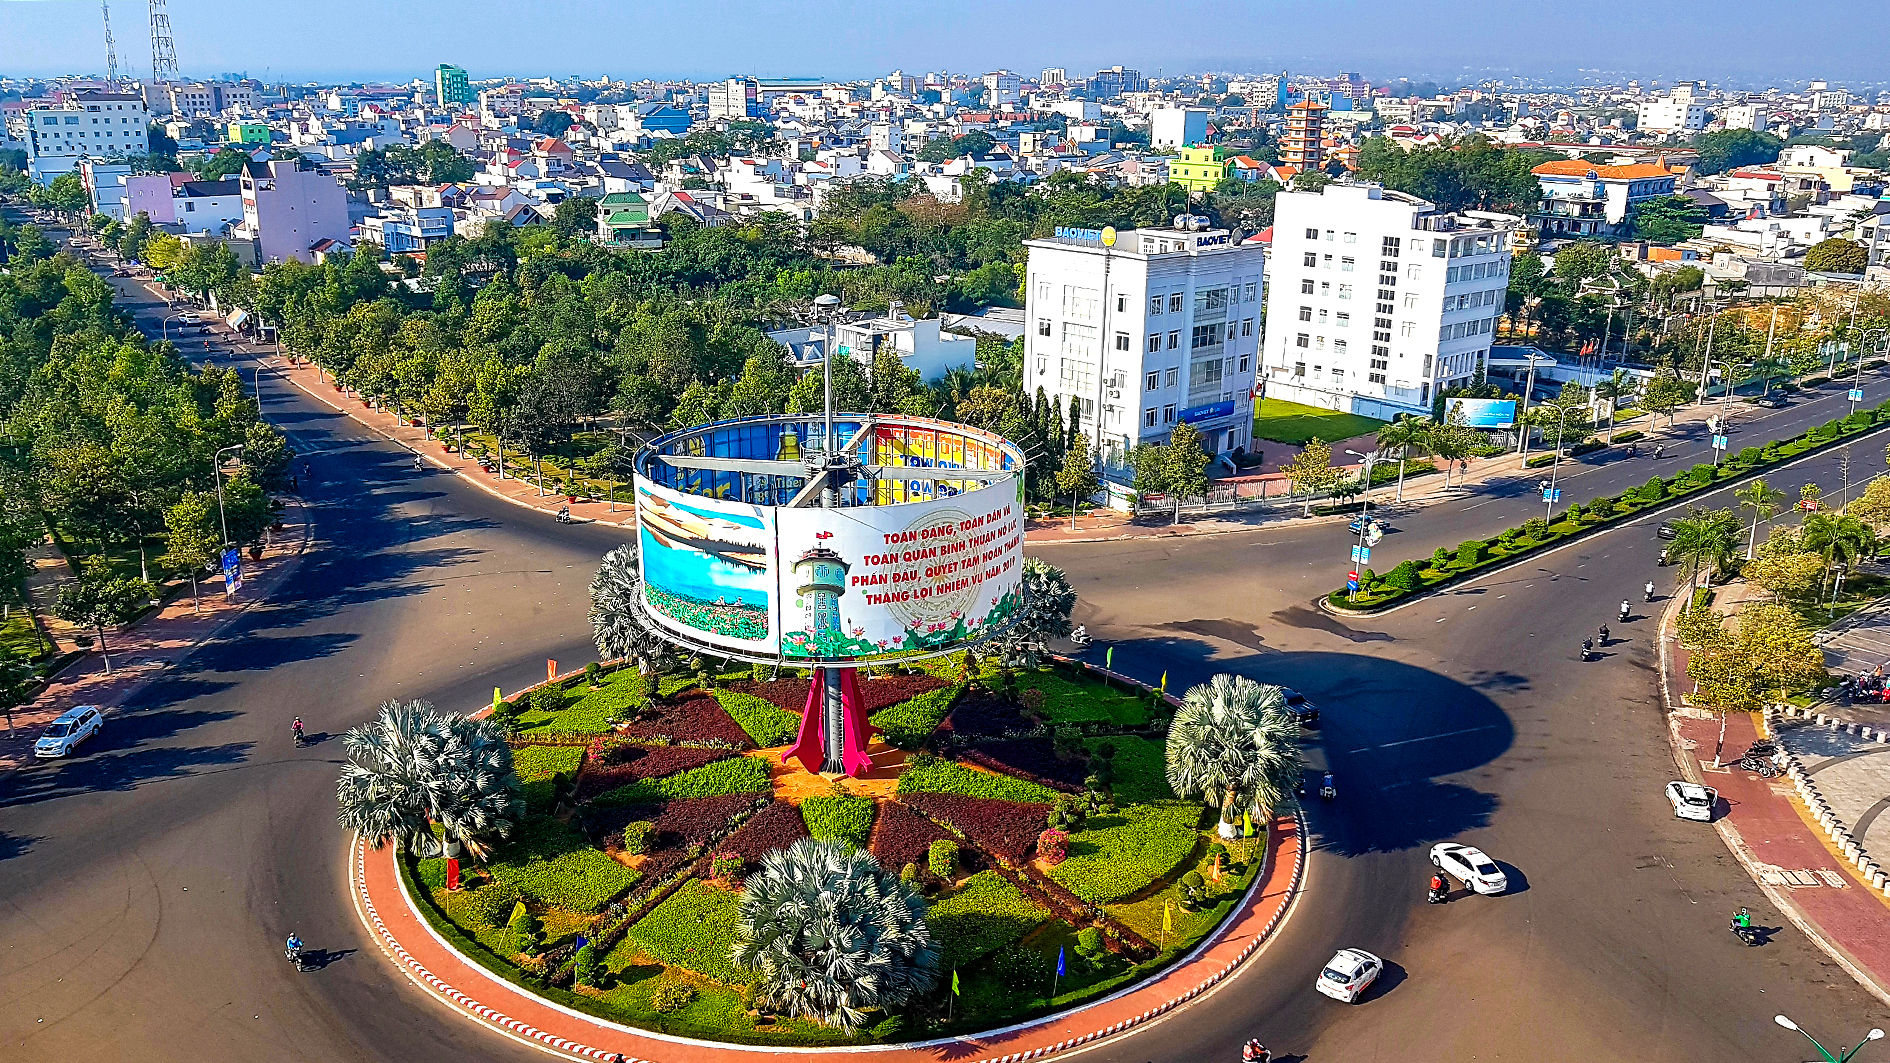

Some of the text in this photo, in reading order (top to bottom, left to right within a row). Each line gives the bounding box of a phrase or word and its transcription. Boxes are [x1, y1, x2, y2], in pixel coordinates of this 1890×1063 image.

[883, 529, 917, 544] TOÀN
[960, 515, 984, 531] TOÀN
[864, 552, 898, 566] TOÀN
[852, 571, 888, 586] PHẤN
